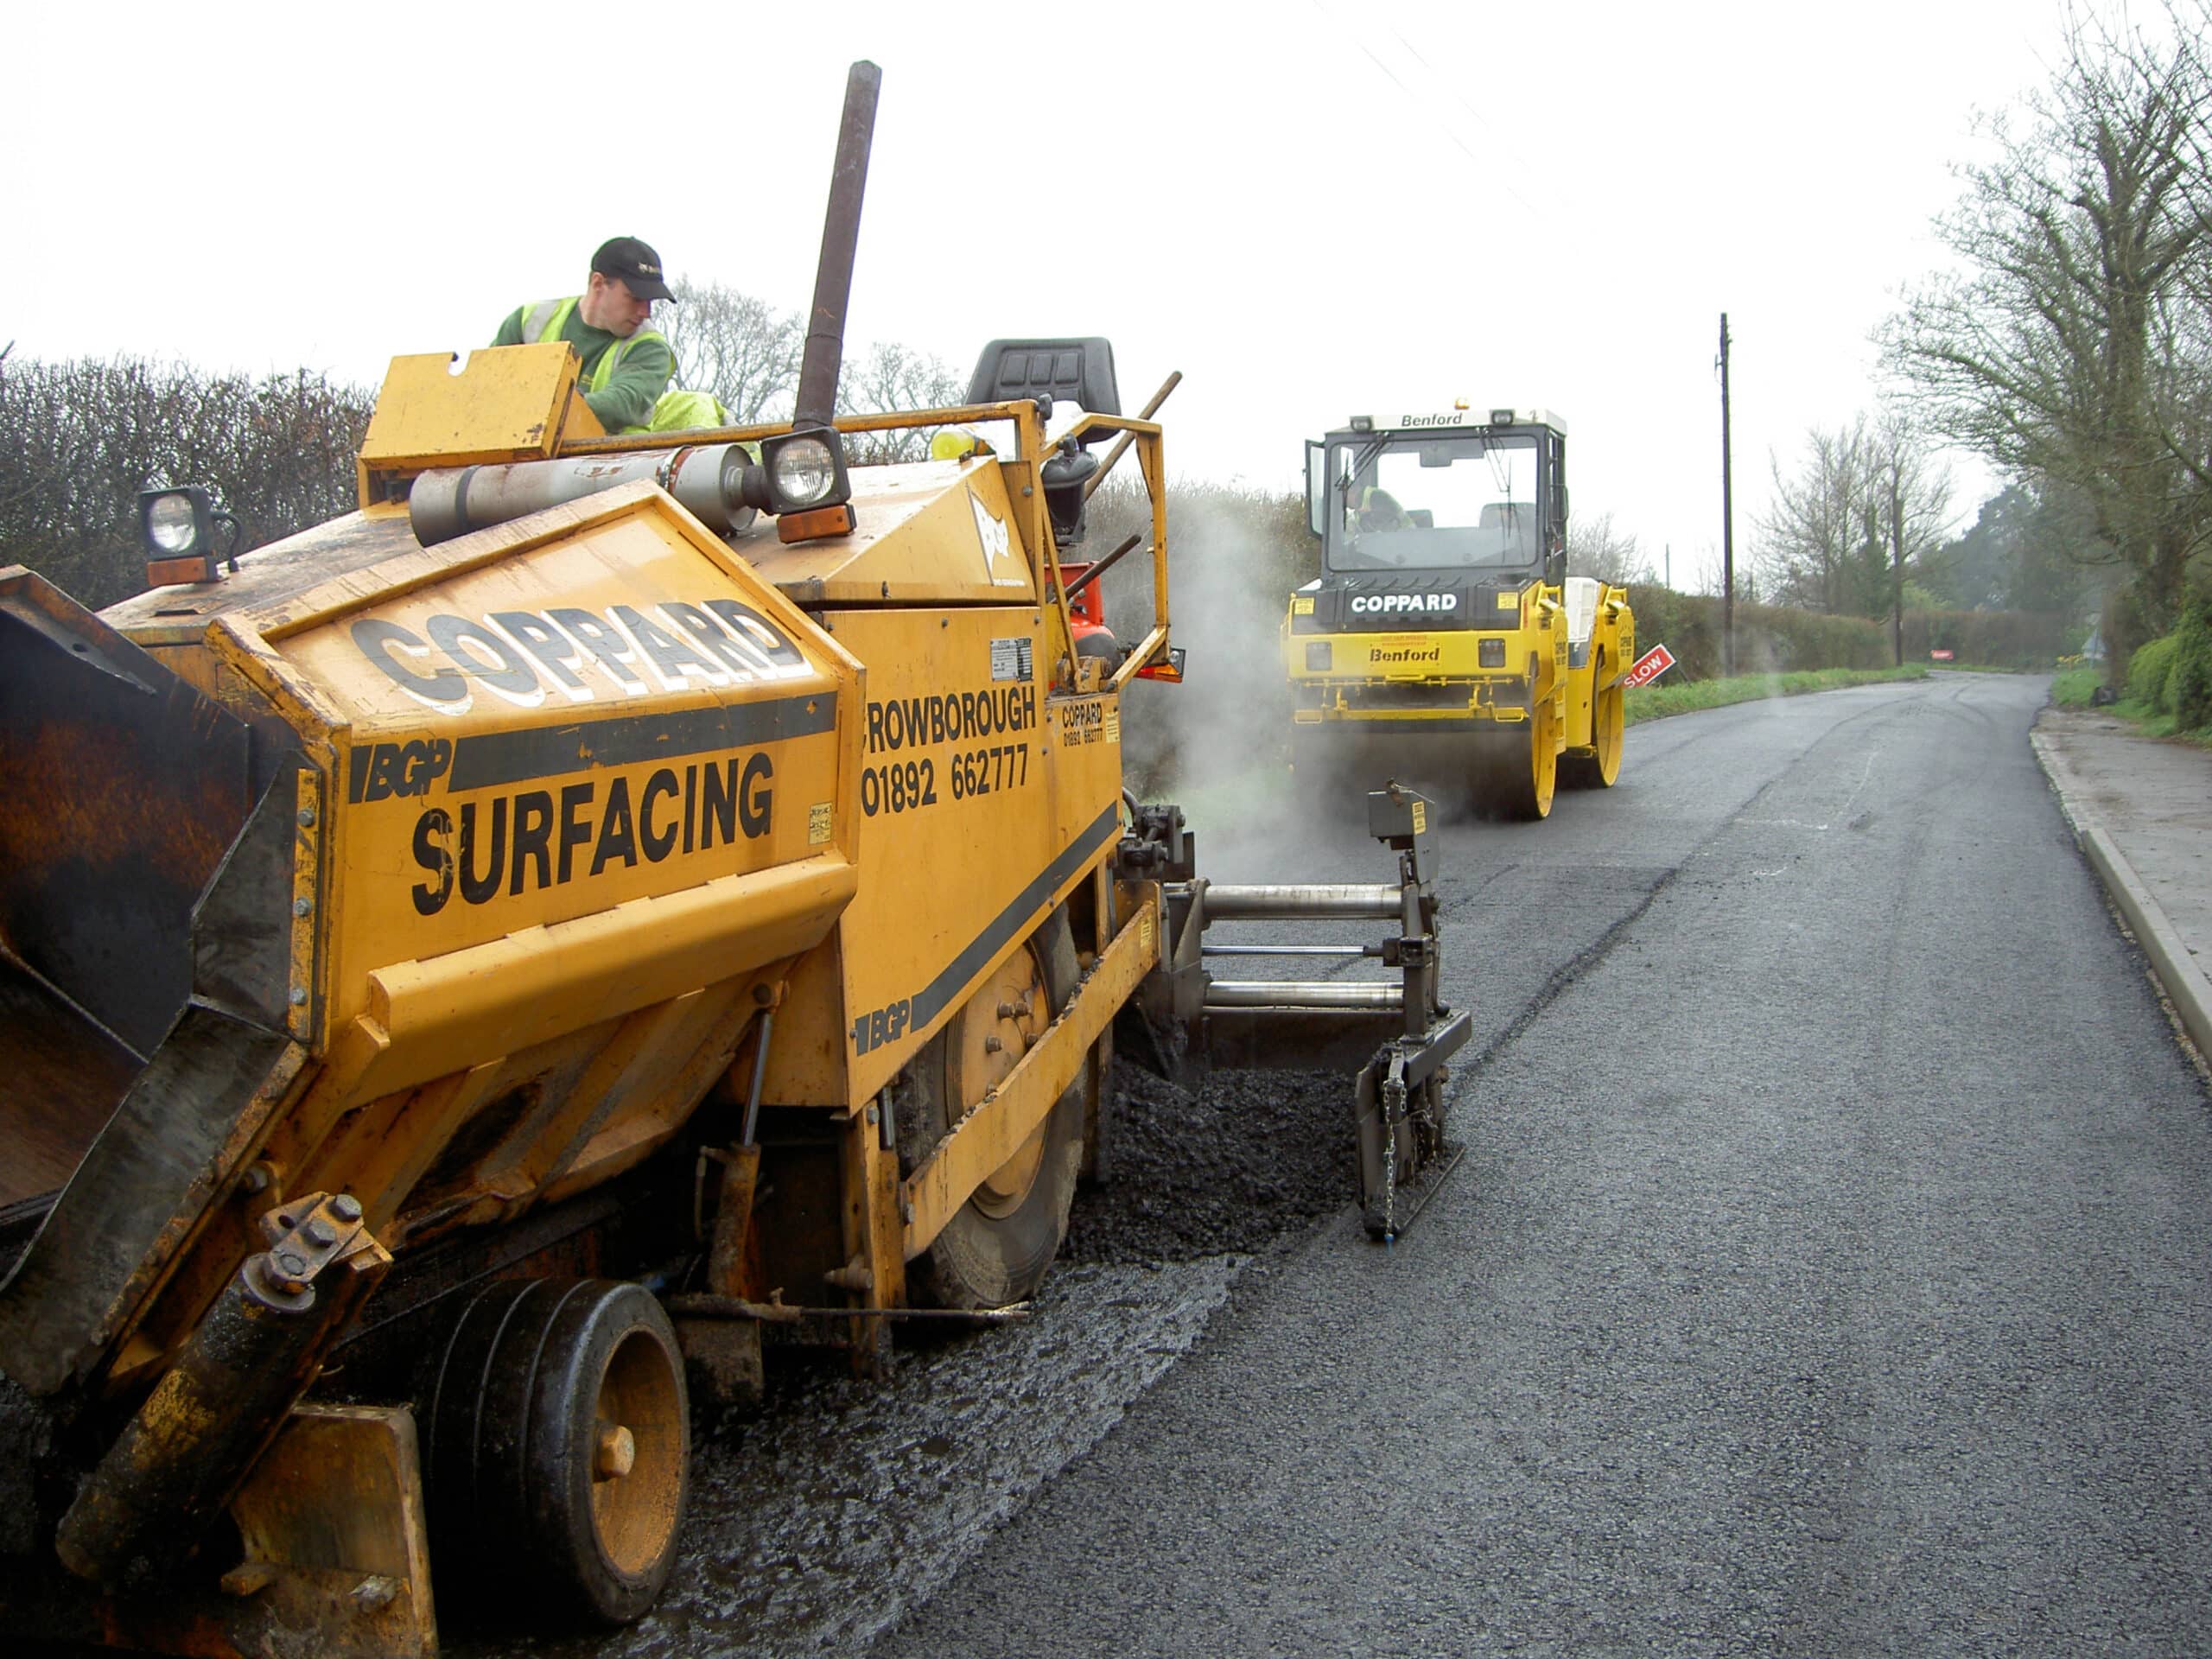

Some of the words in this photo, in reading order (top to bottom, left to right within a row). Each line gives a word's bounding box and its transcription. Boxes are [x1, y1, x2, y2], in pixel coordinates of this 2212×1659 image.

[1401, 412, 1463, 427] Benford
[1351, 594, 1458, 613] COPPARD
[350, 599, 815, 716] COPPARD
[1370, 647, 1440, 662] Benford
[1624, 654, 1662, 689] SLOW
[864, 685, 1036, 753] ROWBOROUGH
[1063, 702, 1102, 728] COPPARD
[861, 758, 937, 817] 01892
[951, 743, 1028, 800] 662777
[411, 752, 773, 916] SURFACING
